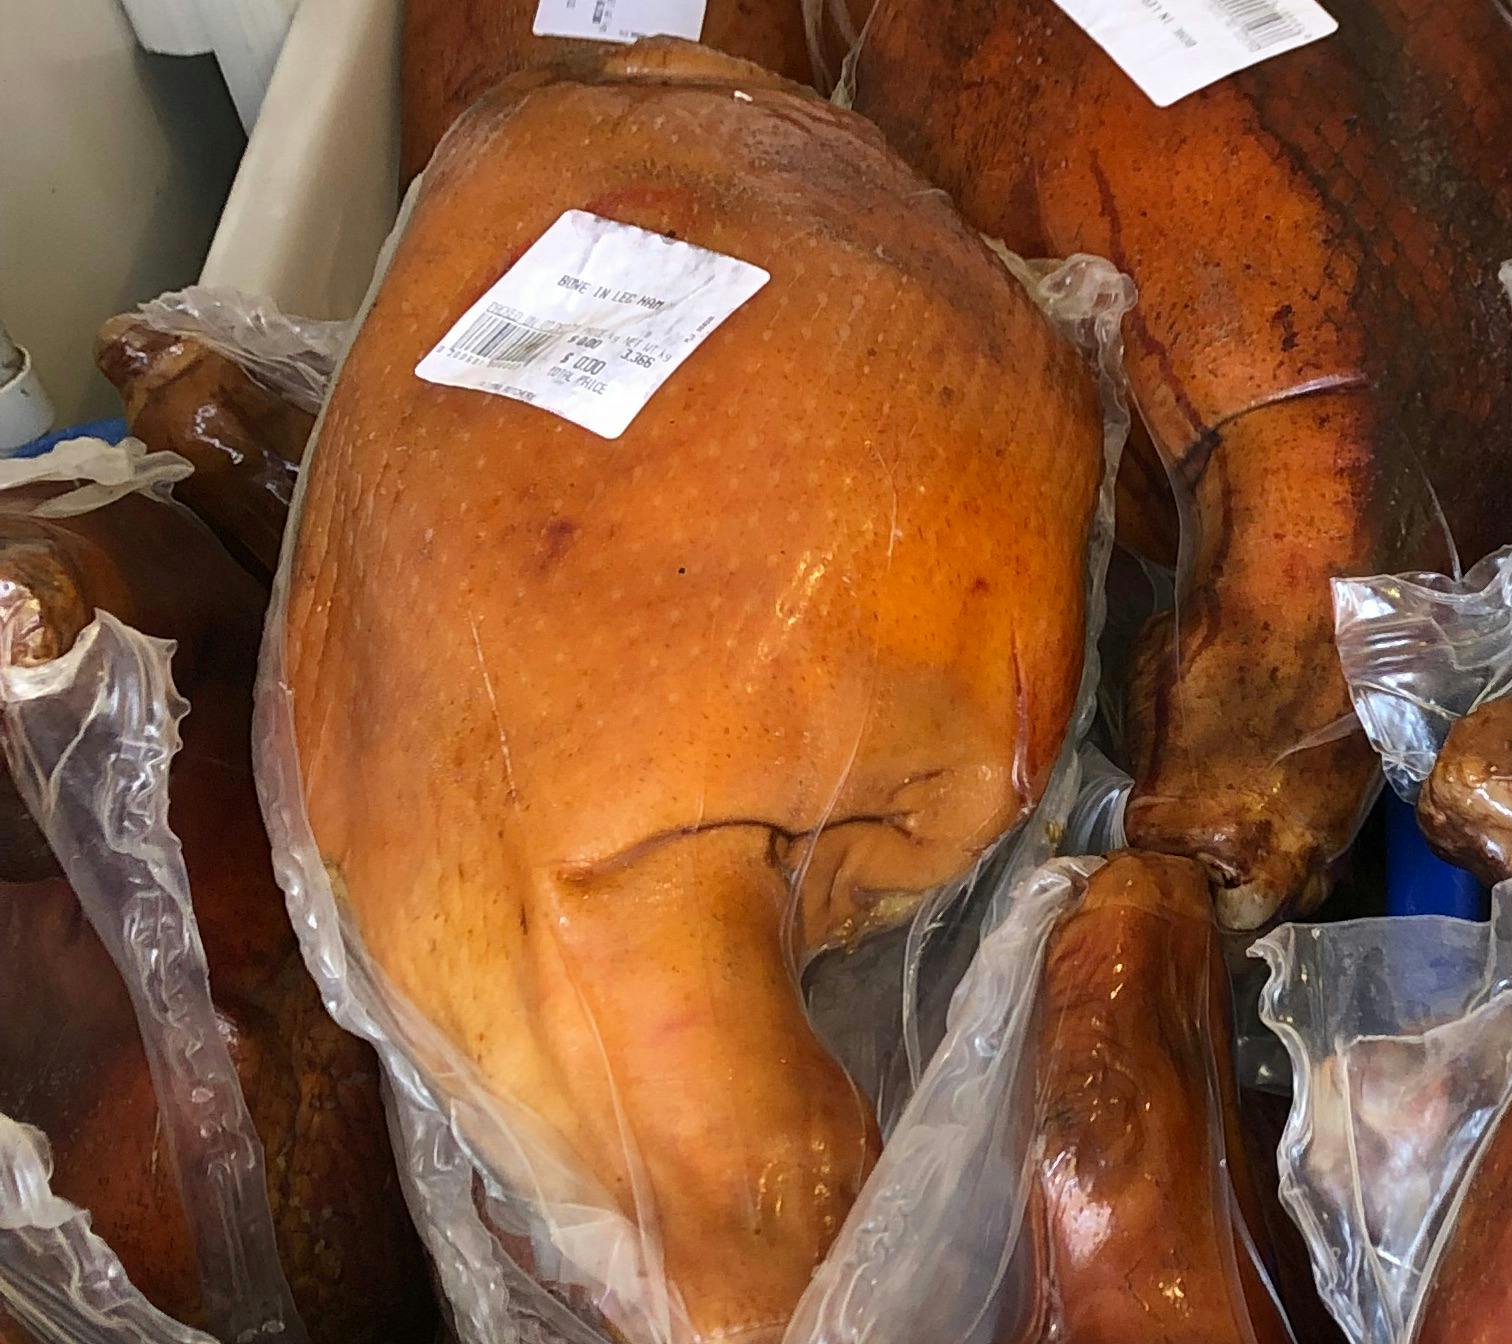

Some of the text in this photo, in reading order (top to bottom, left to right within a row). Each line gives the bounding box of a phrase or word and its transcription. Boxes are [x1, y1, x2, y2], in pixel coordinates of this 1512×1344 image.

[593, 286, 612, 299] IN
[612, 290, 638, 304] LEG
[637, 296, 665, 310] HAM
